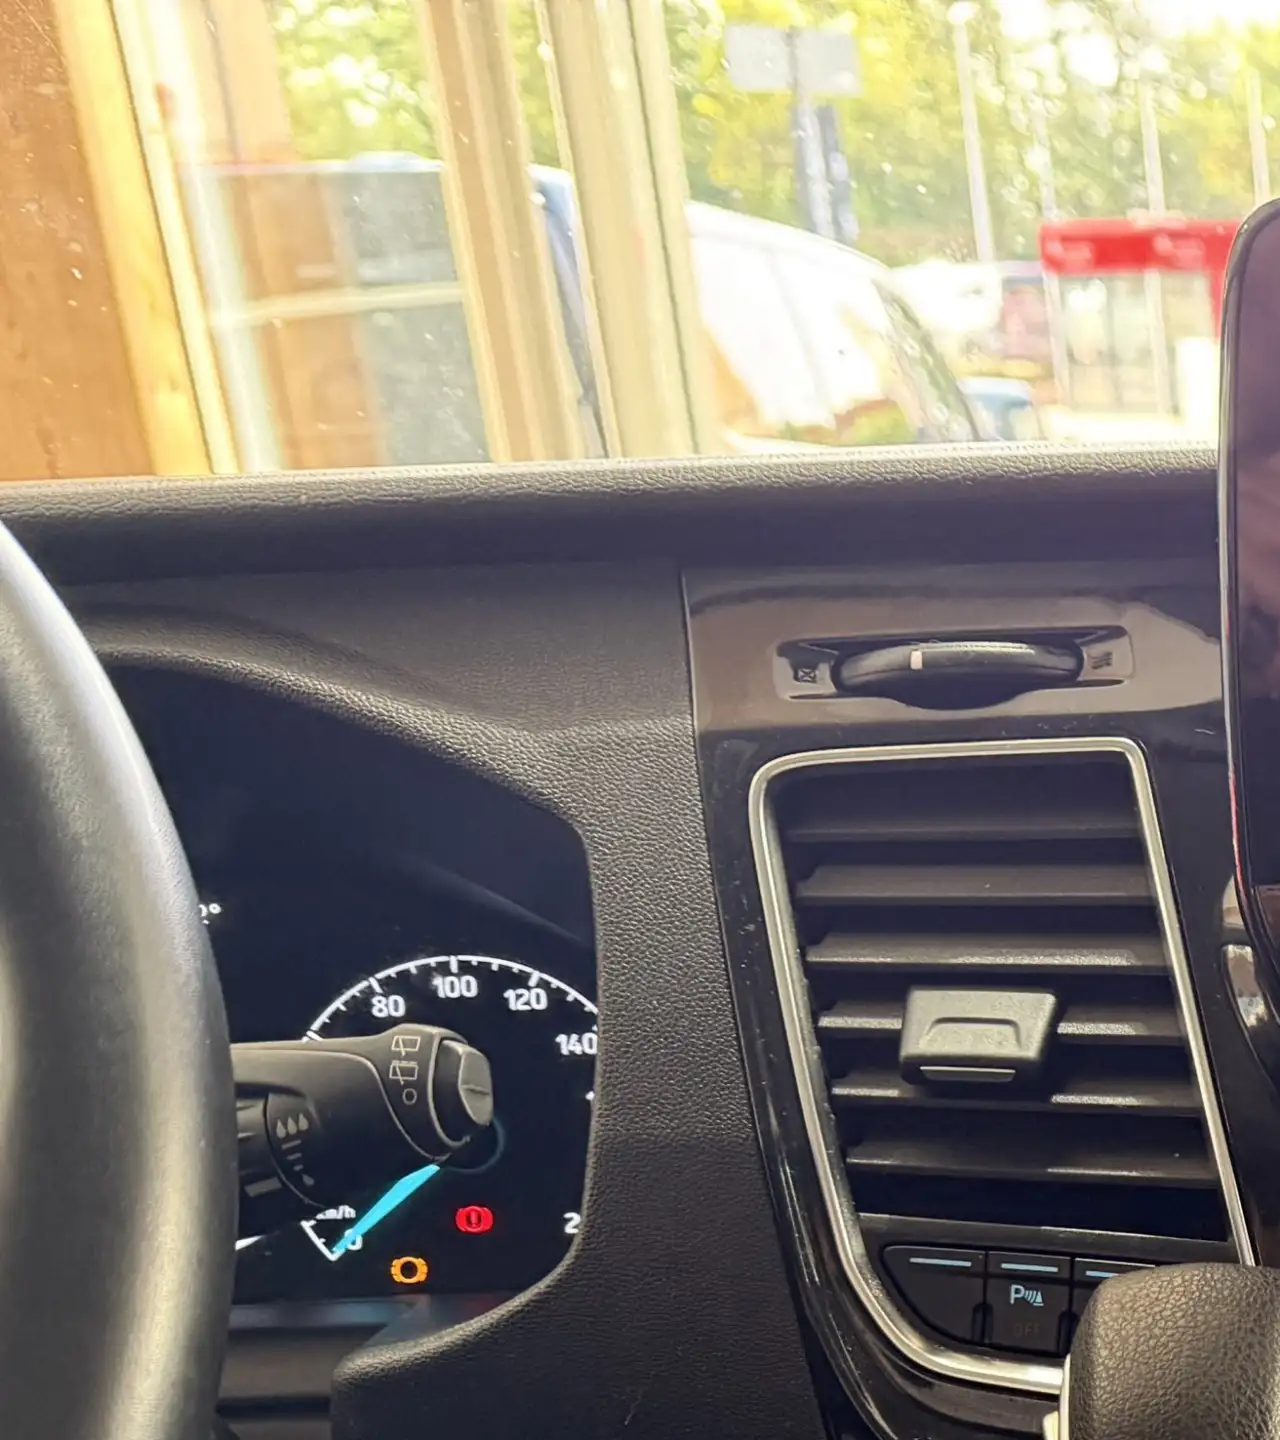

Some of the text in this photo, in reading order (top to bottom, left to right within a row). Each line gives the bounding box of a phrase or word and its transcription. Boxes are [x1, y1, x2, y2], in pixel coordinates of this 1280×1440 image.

[432, 975, 478, 999] 100
[371, 995, 406, 1018] 80
[503, 988, 548, 1011] 120
[555, 1032, 598, 1055] 140
